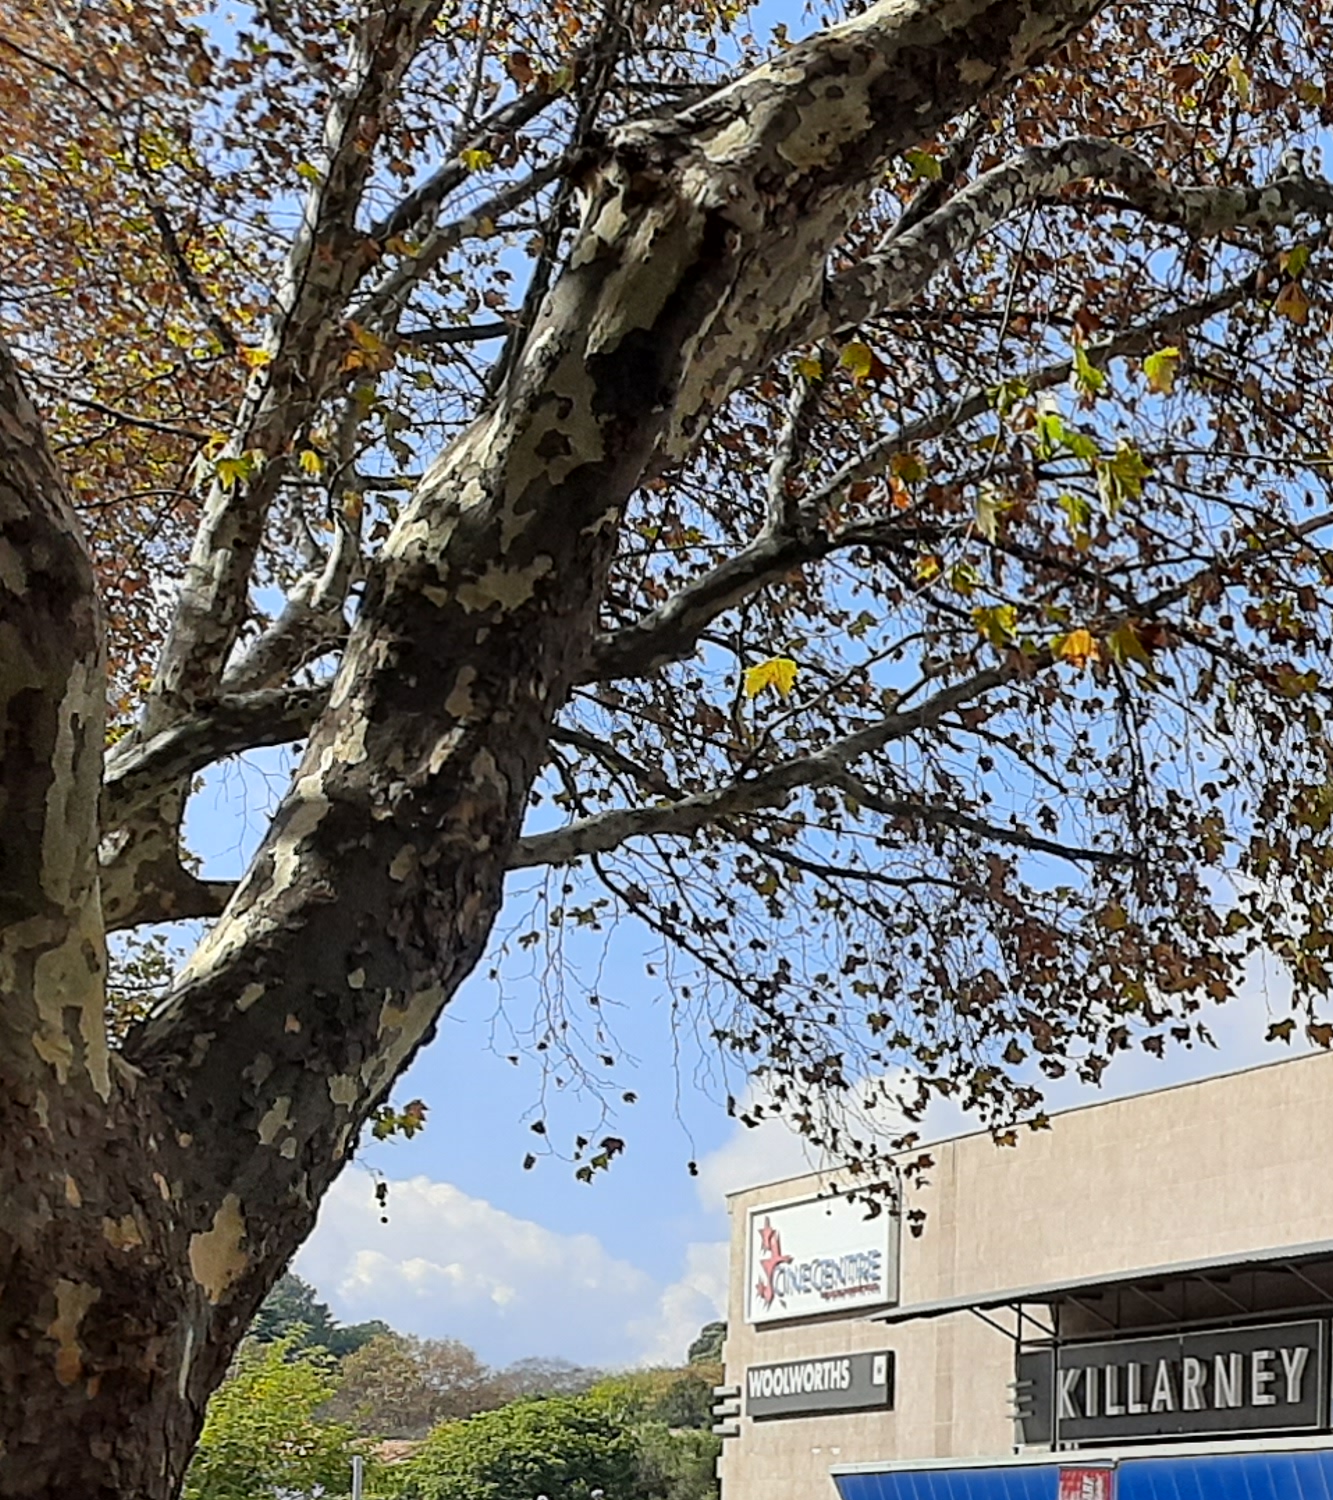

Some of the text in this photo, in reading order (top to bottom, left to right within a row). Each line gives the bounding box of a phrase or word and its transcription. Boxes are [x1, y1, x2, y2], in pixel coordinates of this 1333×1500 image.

[775, 1250, 882, 1298] CINECENTRE
[748, 1359, 850, 1398] WOOLWORTHS
[1057, 1346, 1311, 1419] KILLARNEY
